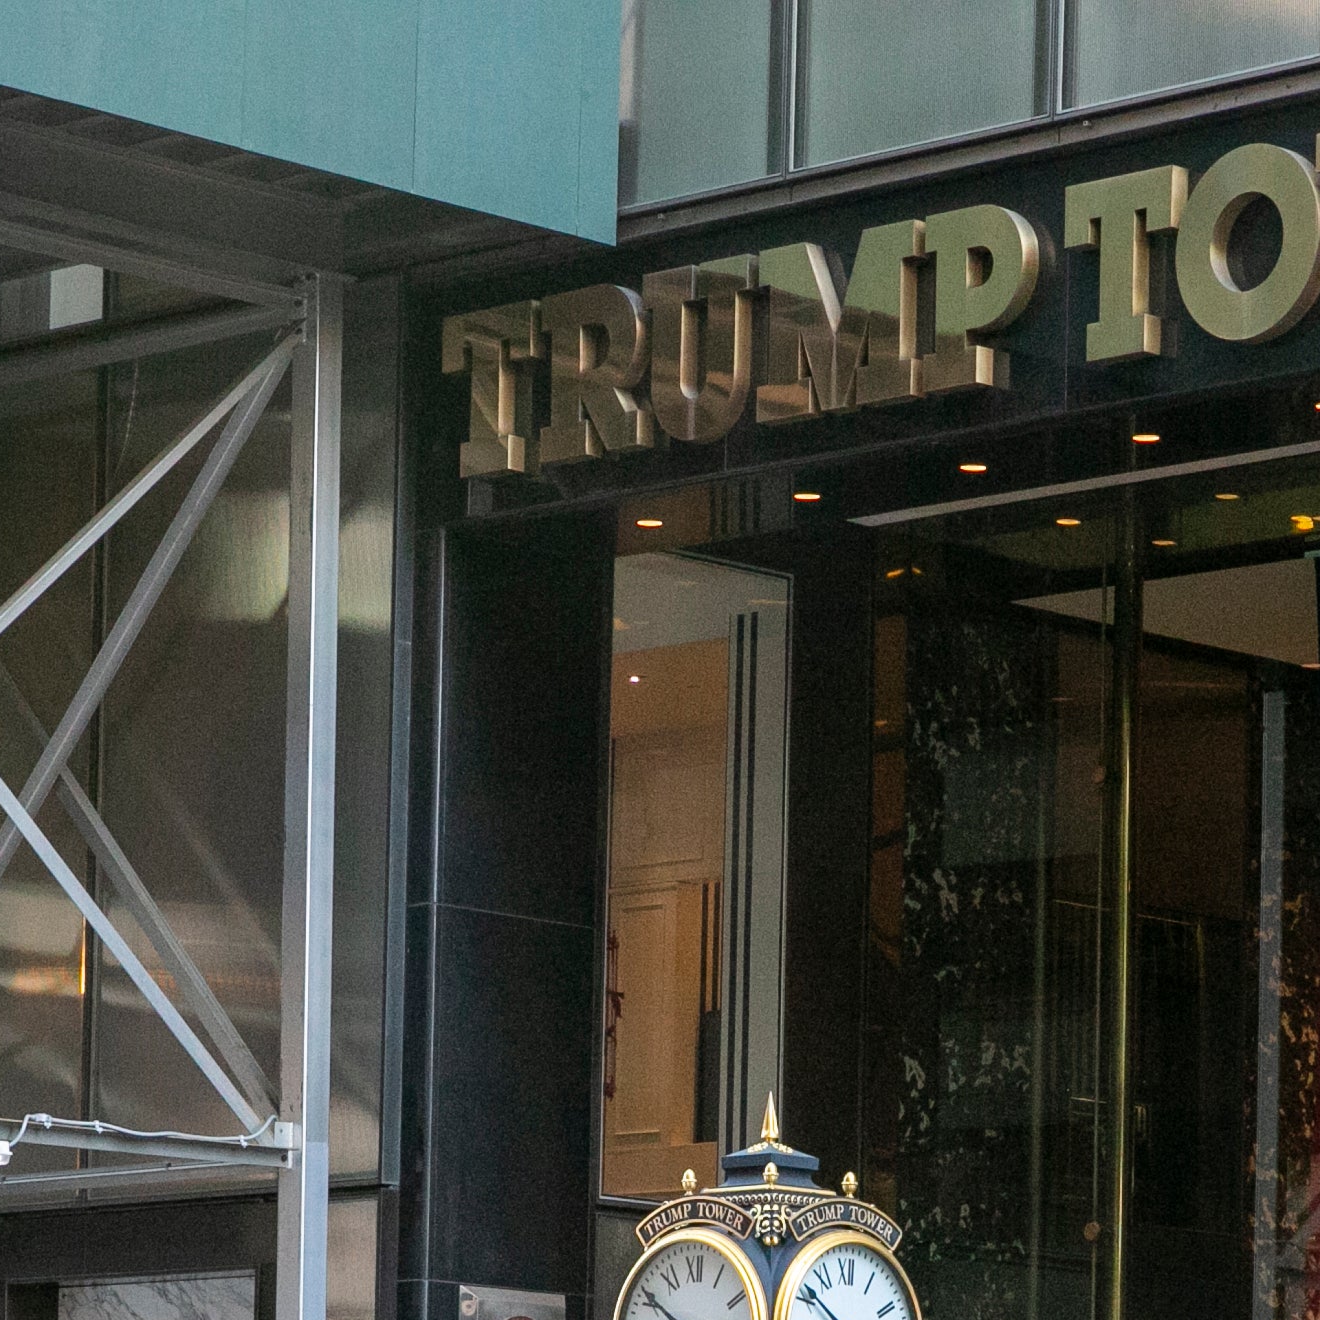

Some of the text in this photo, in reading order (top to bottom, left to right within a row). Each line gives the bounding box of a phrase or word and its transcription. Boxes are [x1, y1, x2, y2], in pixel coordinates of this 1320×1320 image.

[442, 204, 1041, 478] TRUMP
[643, 1203, 744, 1237] TRUMP TOWER
[796, 1204, 895, 1242] TRUMP TOWER
